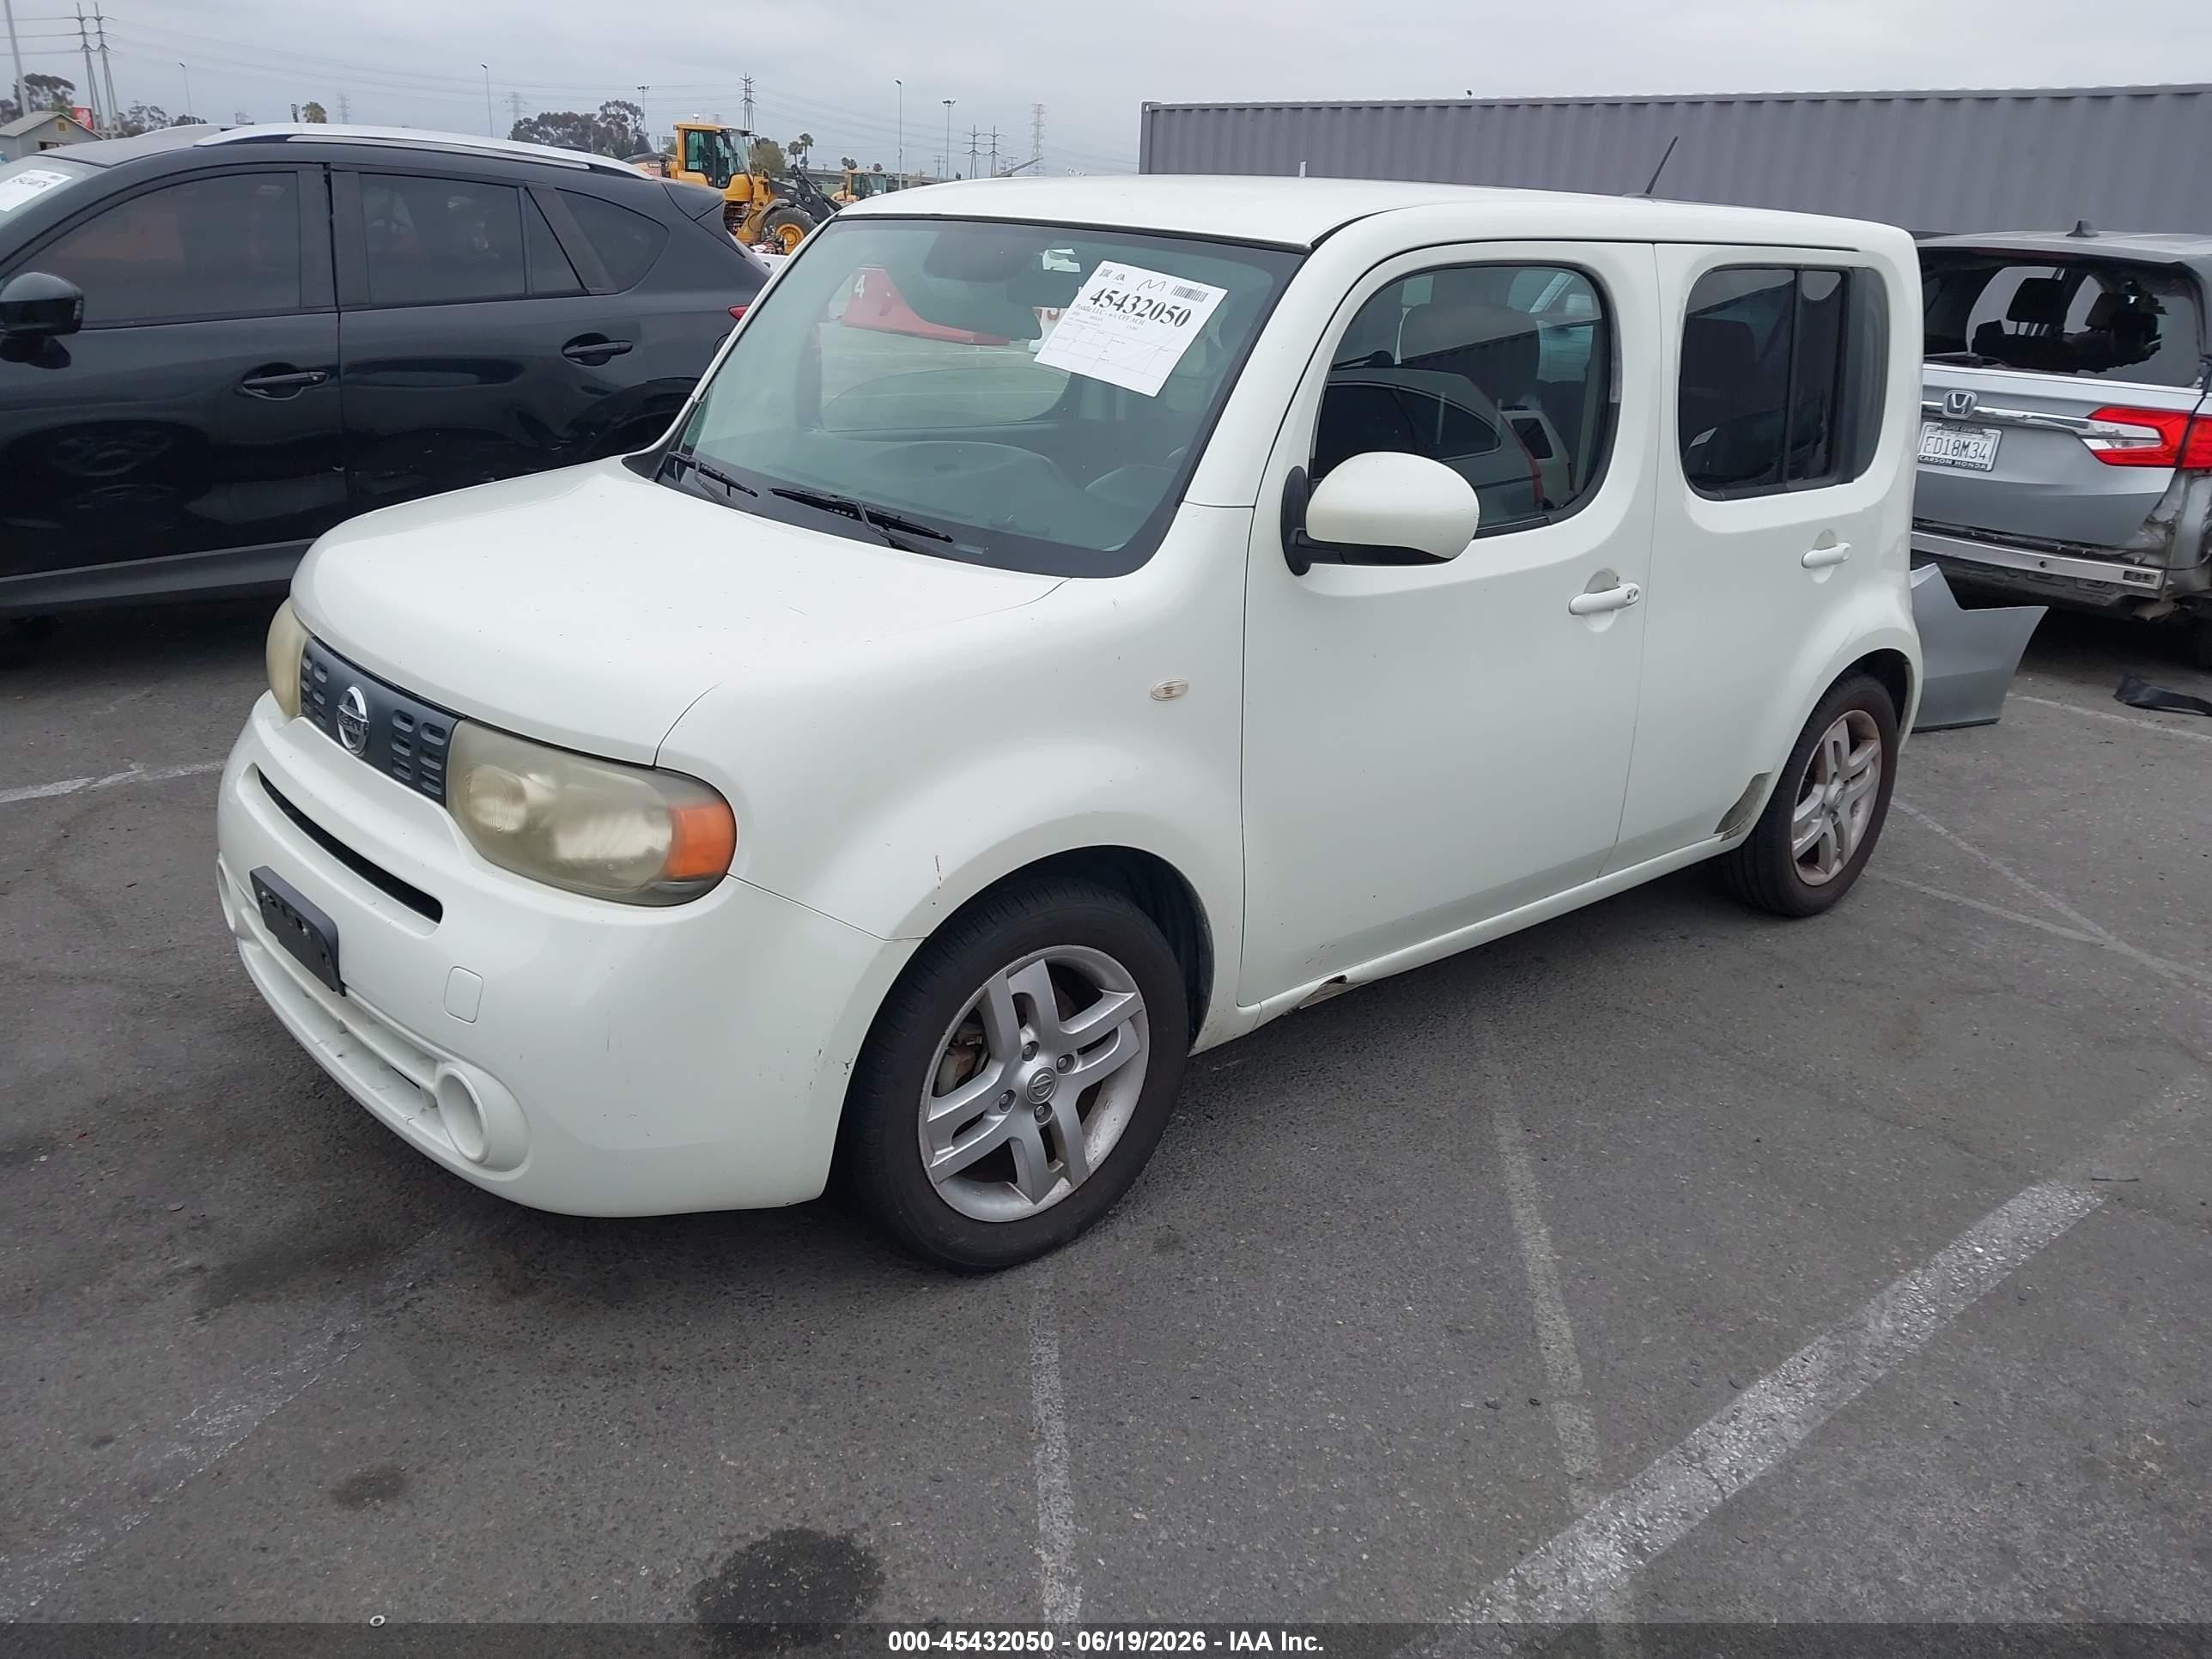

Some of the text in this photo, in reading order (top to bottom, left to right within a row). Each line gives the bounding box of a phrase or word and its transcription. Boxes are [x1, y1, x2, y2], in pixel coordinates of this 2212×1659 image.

[854, 274, 866, 299] 4
[1090, 288, 1192, 327] 45432050
[1923, 435, 1988, 460] ED18M34
[1918, 455, 1986, 470] CARSON HONDA
